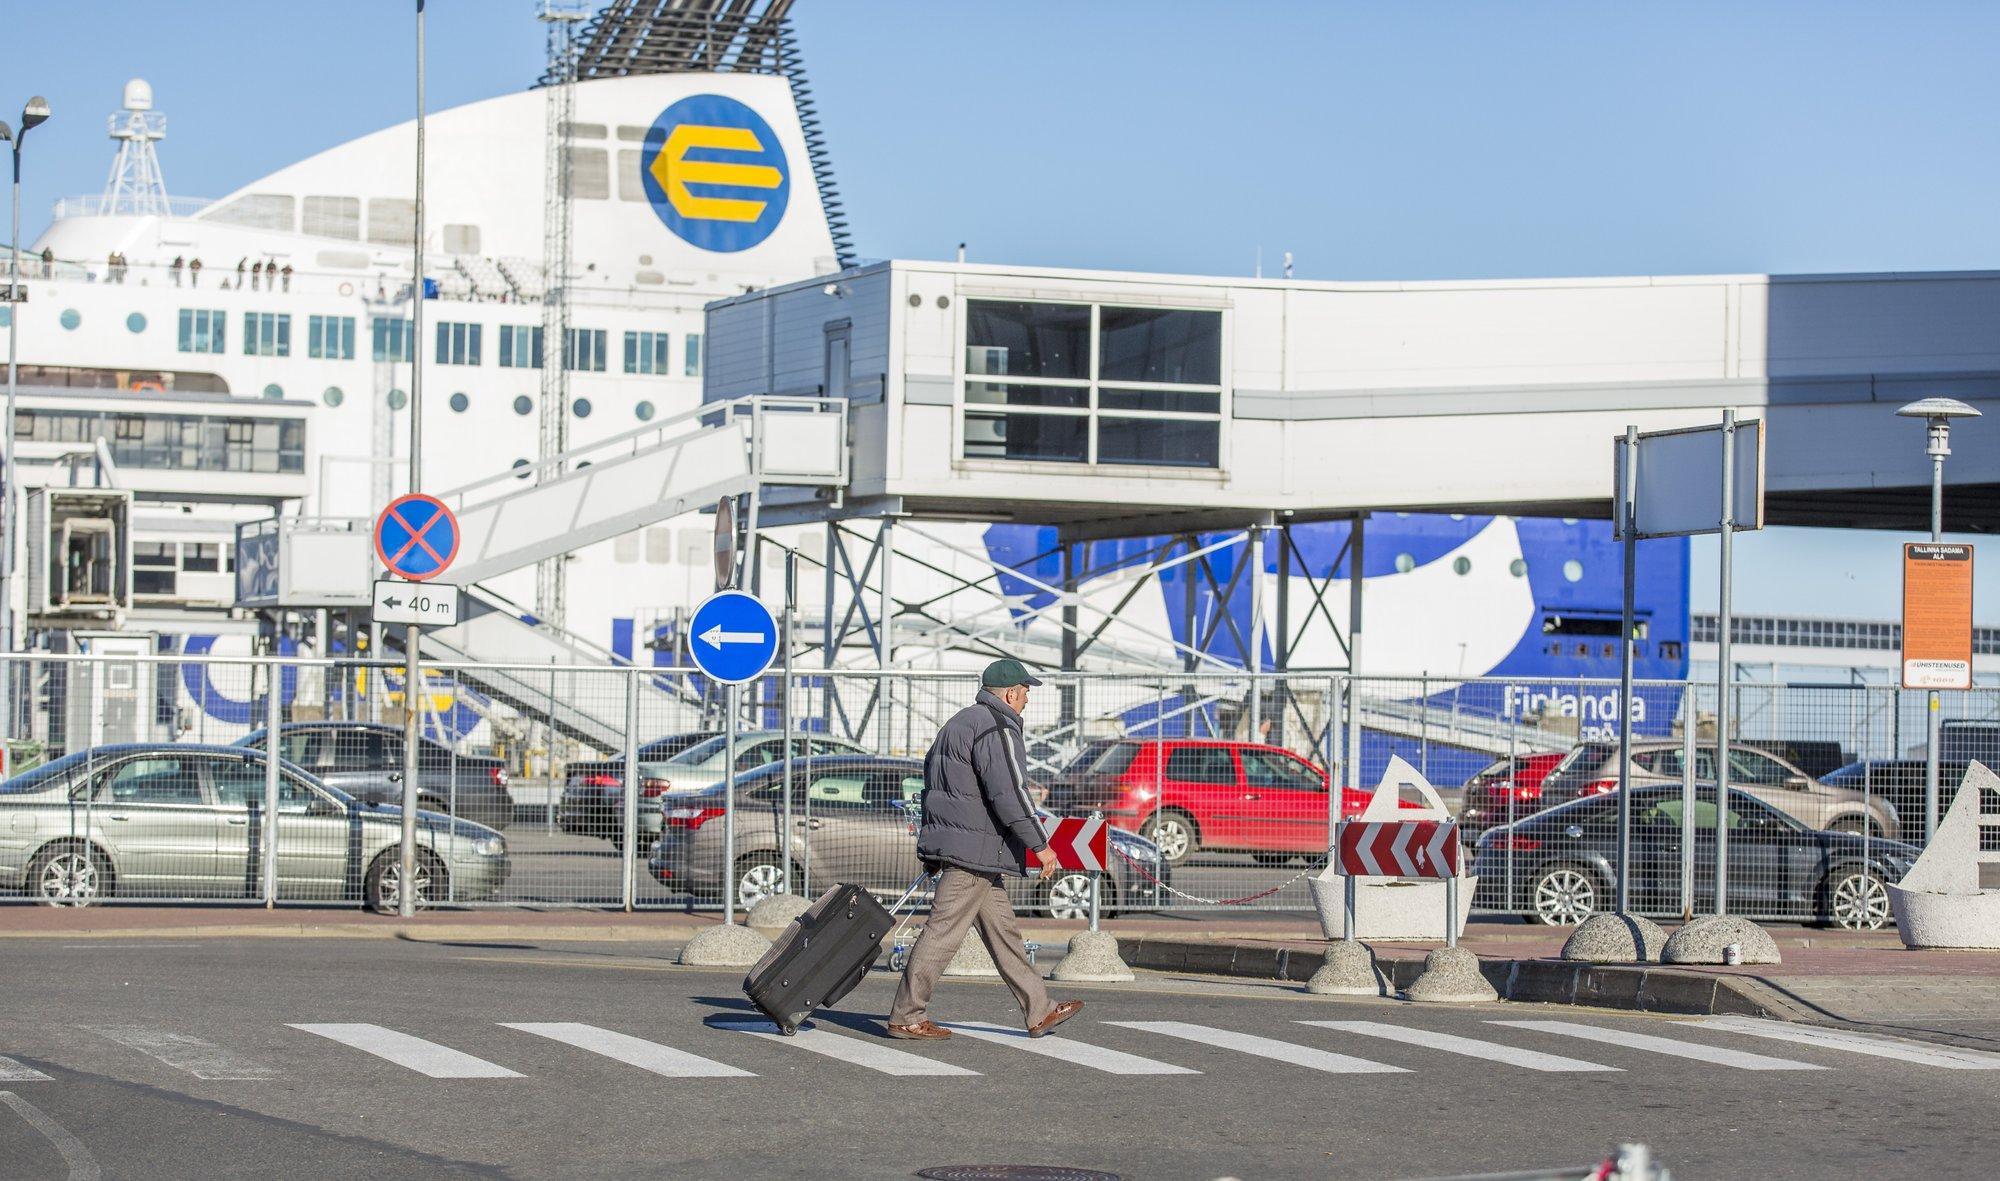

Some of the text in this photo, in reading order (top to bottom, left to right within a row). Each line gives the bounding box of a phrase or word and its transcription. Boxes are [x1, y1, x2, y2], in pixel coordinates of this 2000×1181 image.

[409, 597, 449, 613] 40 m
[1504, 686, 1645, 722] Finlanda
